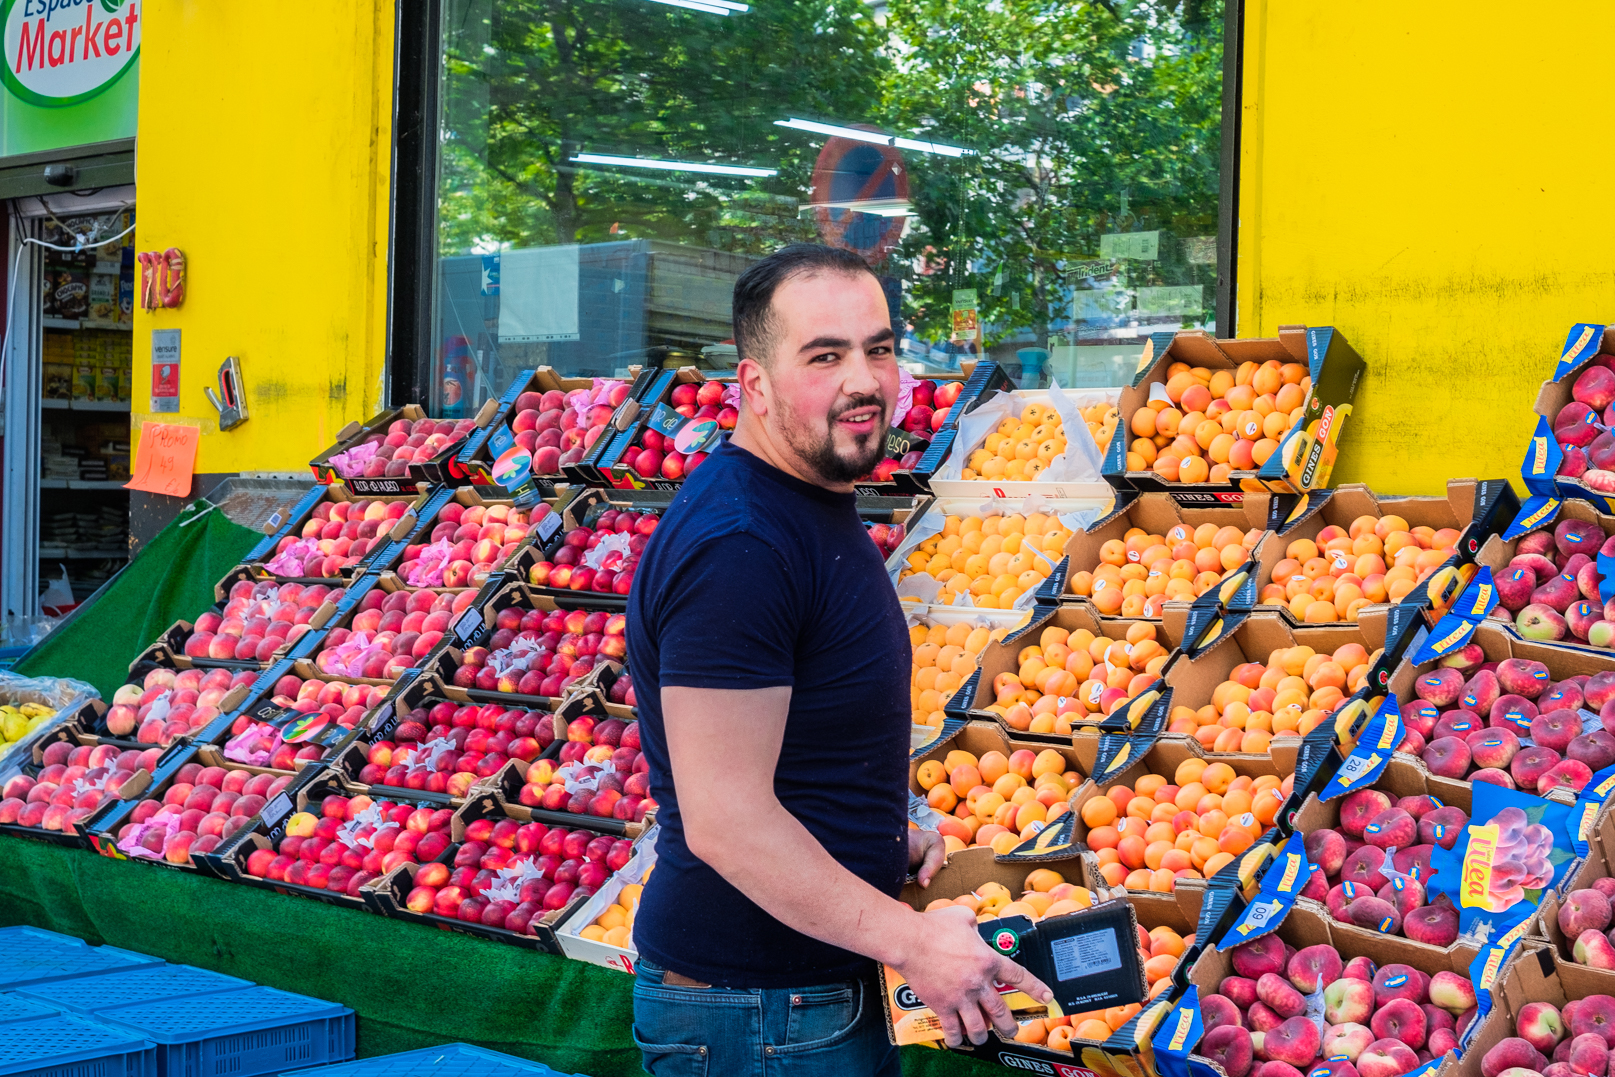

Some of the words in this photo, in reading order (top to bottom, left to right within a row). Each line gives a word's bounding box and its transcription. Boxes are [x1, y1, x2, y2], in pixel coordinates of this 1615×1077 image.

[24, 0, 94, 22] Espa
[15, 2, 138, 74] Market
[1078, 264, 1110, 279] Trident
[1302, 443, 1321, 484] GINES
[1319, 408, 1333, 439] GON
[1346, 758, 1361, 772] 28
[1005, 1055, 1055, 1075] GINES
[1061, 1067, 1095, 1077] GON
